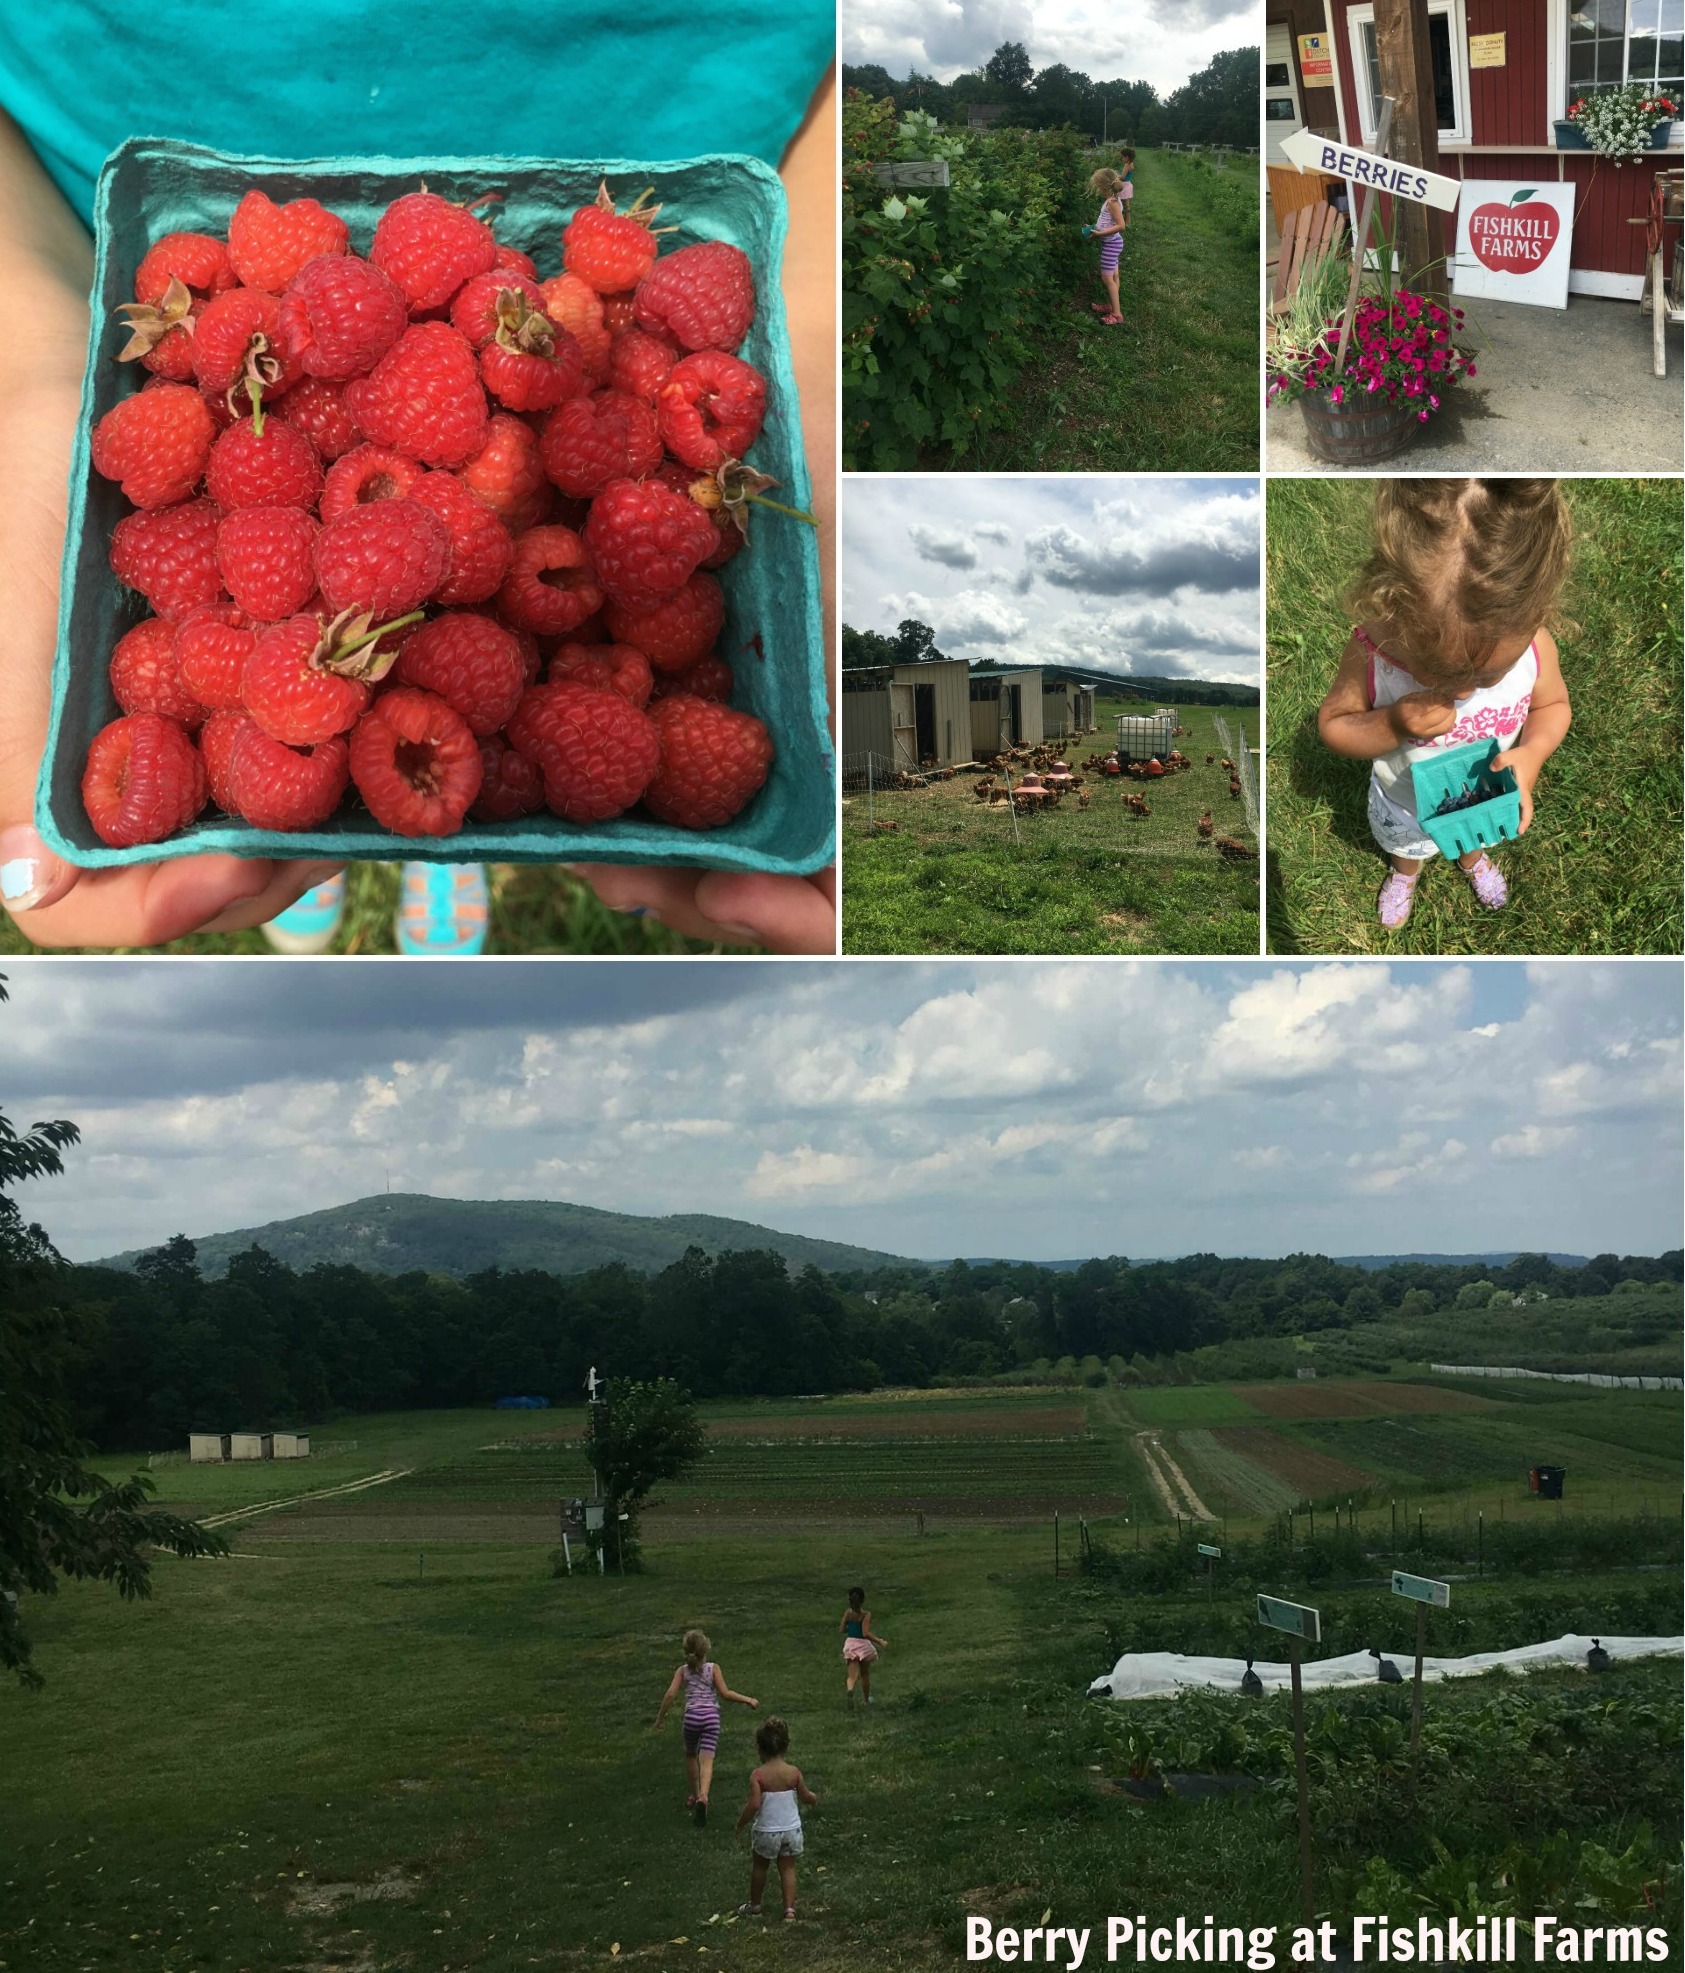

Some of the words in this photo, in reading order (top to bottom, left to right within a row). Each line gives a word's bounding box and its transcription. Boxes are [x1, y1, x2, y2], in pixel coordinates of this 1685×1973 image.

[1321, 146, 1428, 199] BERRIES
[1473, 215, 1553, 240] FISHKILL
[1481, 237, 1542, 260] FARMS
